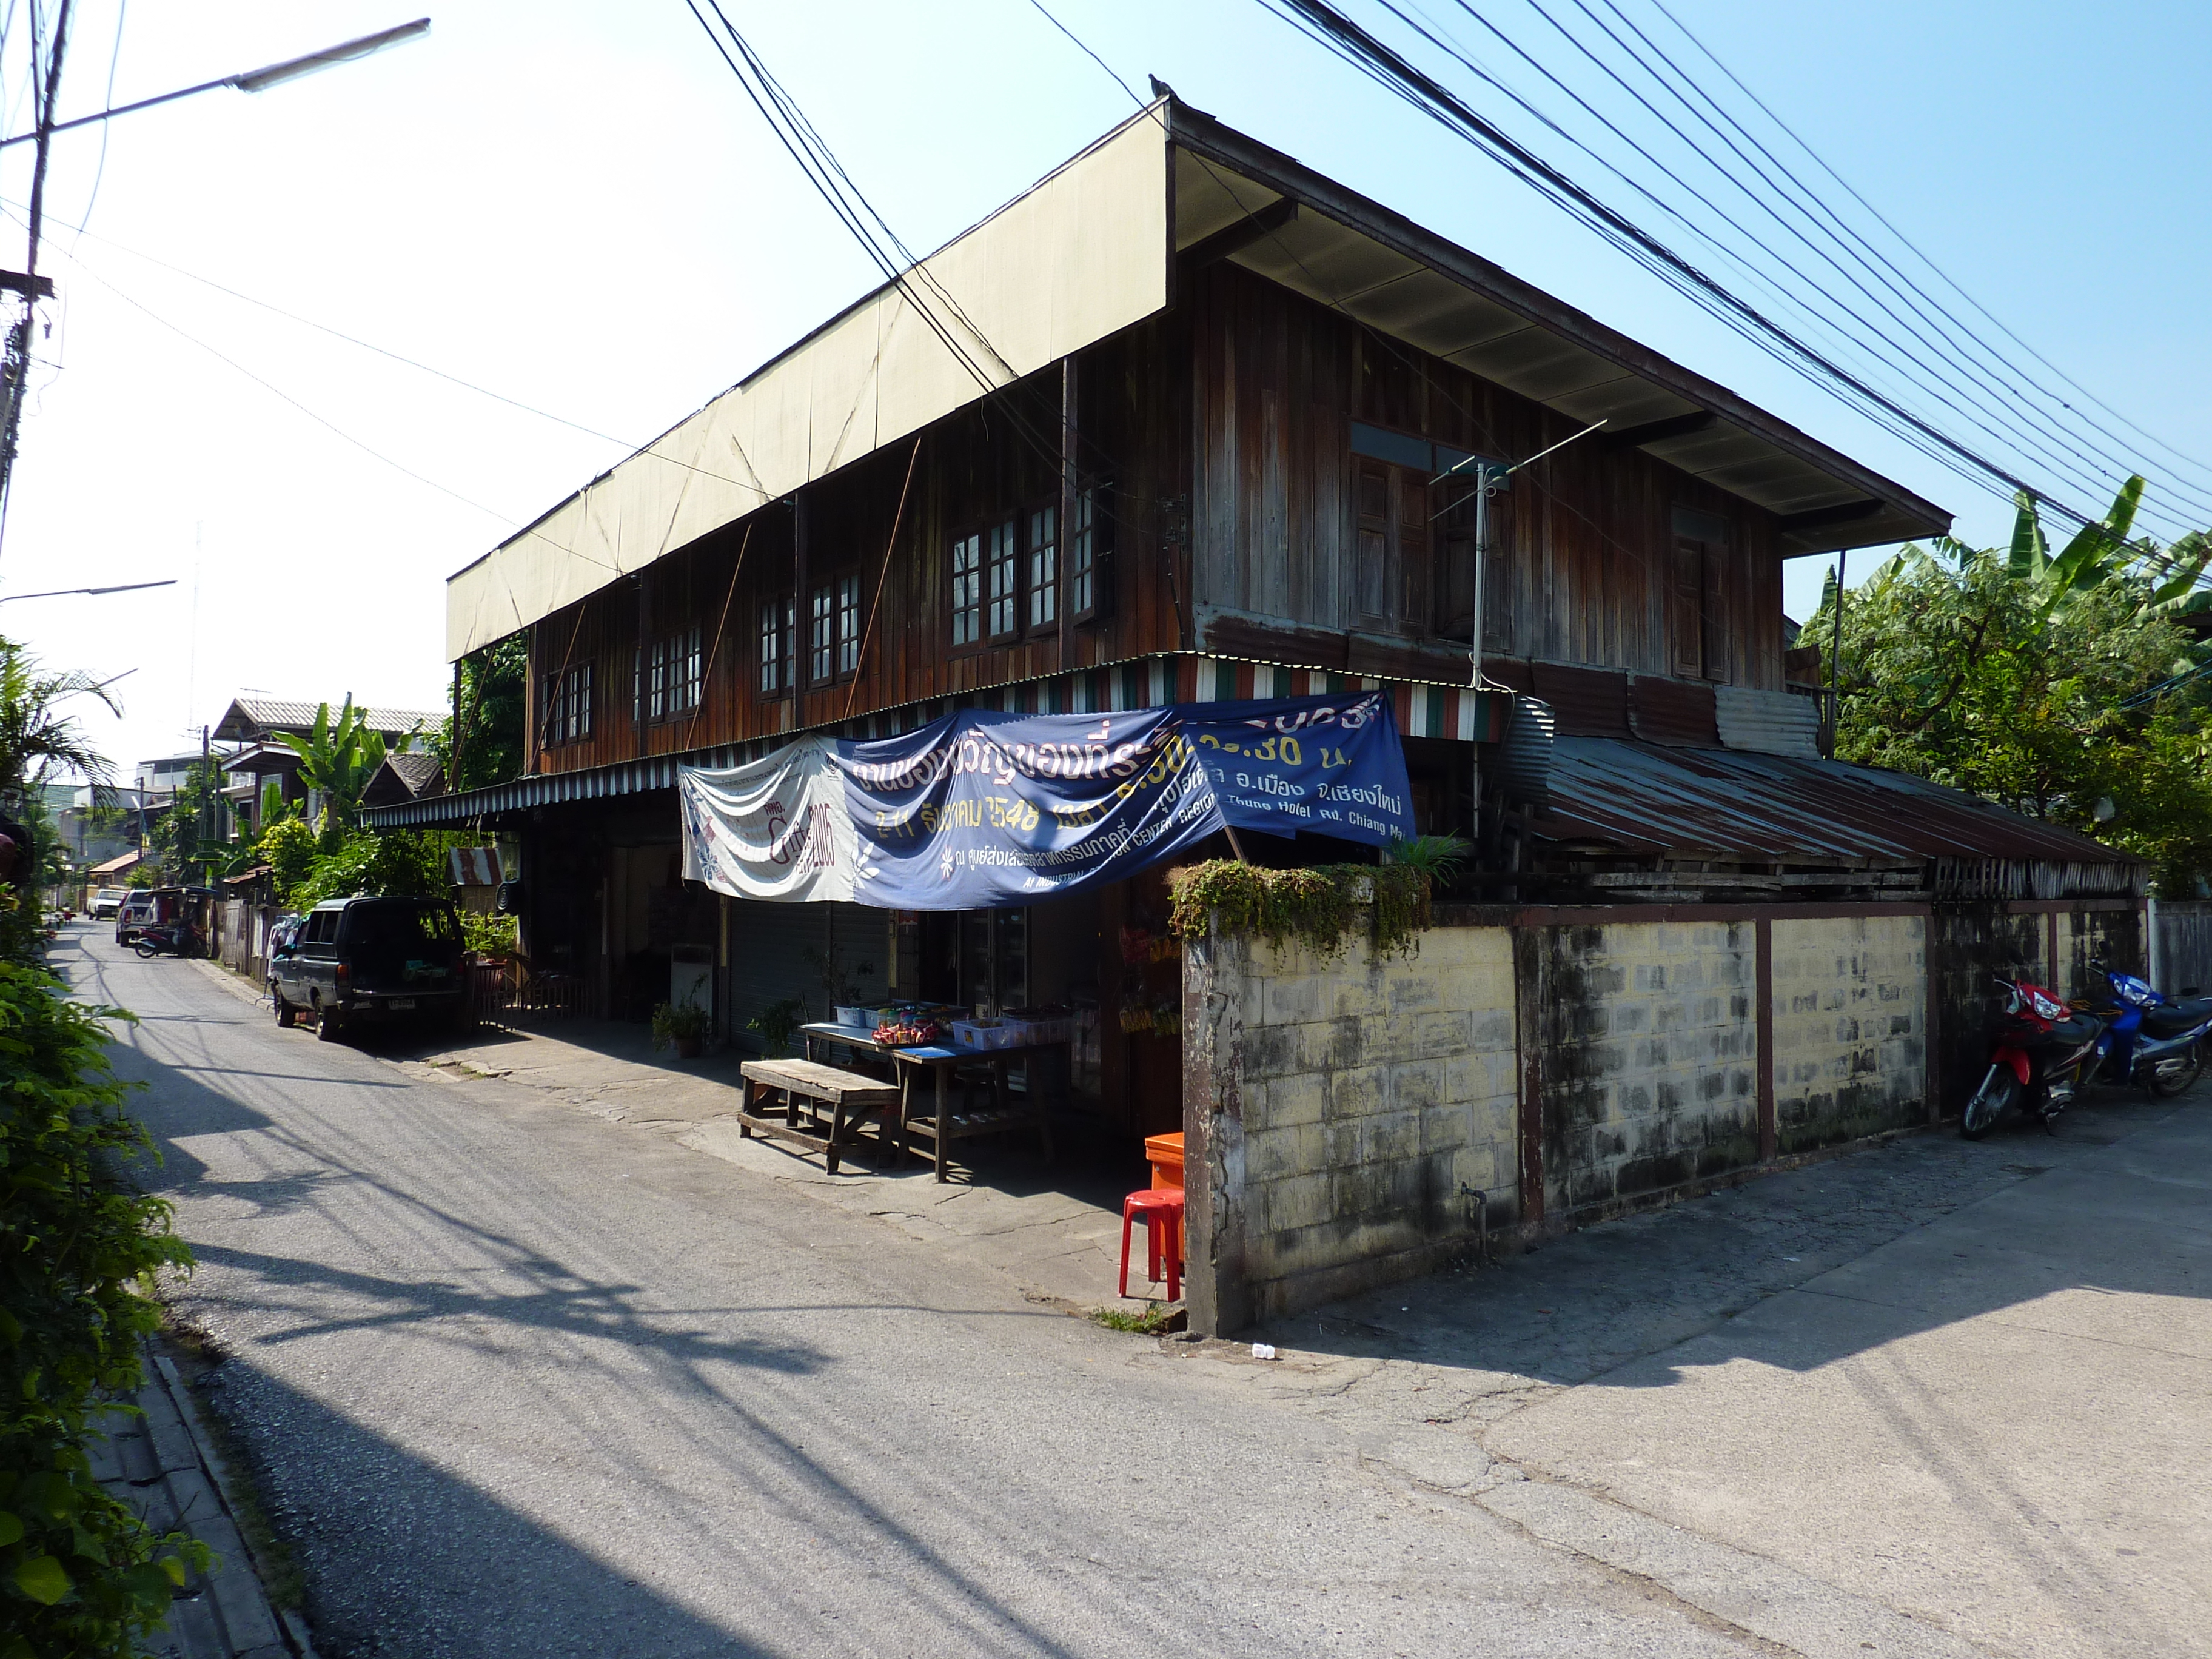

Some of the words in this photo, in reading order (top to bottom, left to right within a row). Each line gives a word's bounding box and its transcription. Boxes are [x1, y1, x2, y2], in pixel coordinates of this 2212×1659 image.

[1236, 773, 1305, 796] อ.เมือง
[808, 803, 835, 867] 2005
[985, 796, 1040, 831] 2548
[1132, 816, 1173, 846] CENTER
[1227, 794, 1272, 811] Thung
[1278, 802, 1311, 818] Hotel
[1319, 809, 1343, 822] Rd.
[1349, 811, 1386, 836] Chiang
